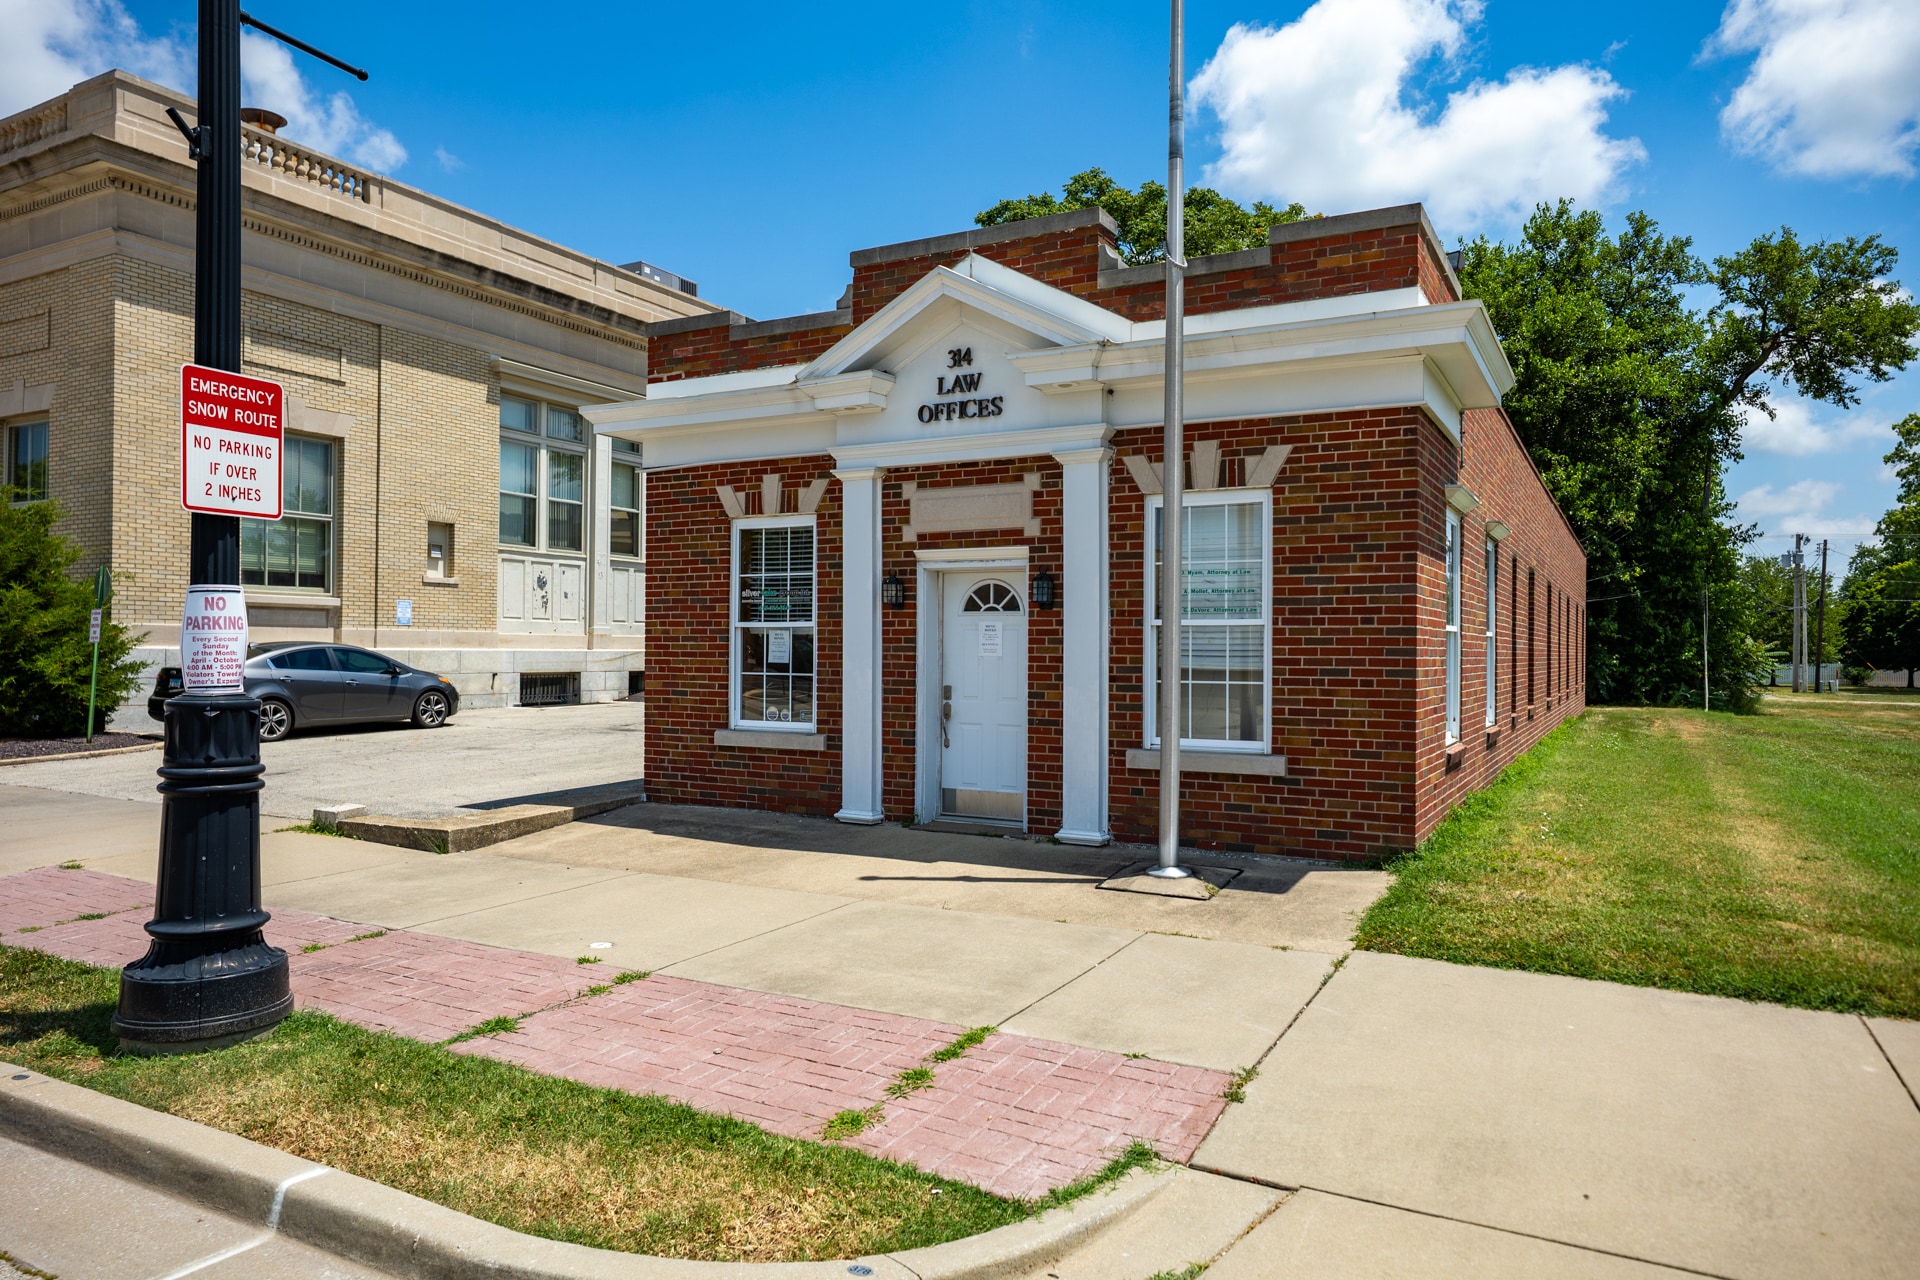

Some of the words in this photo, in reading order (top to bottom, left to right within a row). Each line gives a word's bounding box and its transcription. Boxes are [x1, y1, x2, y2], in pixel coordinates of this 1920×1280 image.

[947, 347, 973, 368] 314
[190, 377, 275, 406] EMERGENCY
[936, 372, 982, 395] LAW
[188, 400, 228, 420] SNOW
[234, 408, 278, 429] ROUTE
[918, 396, 1003, 423] OFFICES
[193, 434, 211, 451] NO
[219, 439, 272, 460] PARKING
[209, 461, 220, 476] IF
[226, 464, 257, 481] OVER
[205, 482, 213, 496] 2
[219, 484, 261, 502] INCHES
[204, 596, 226, 611] NO
[185, 615, 244, 630] PARKING
[202, 643, 229, 651] Sunday
